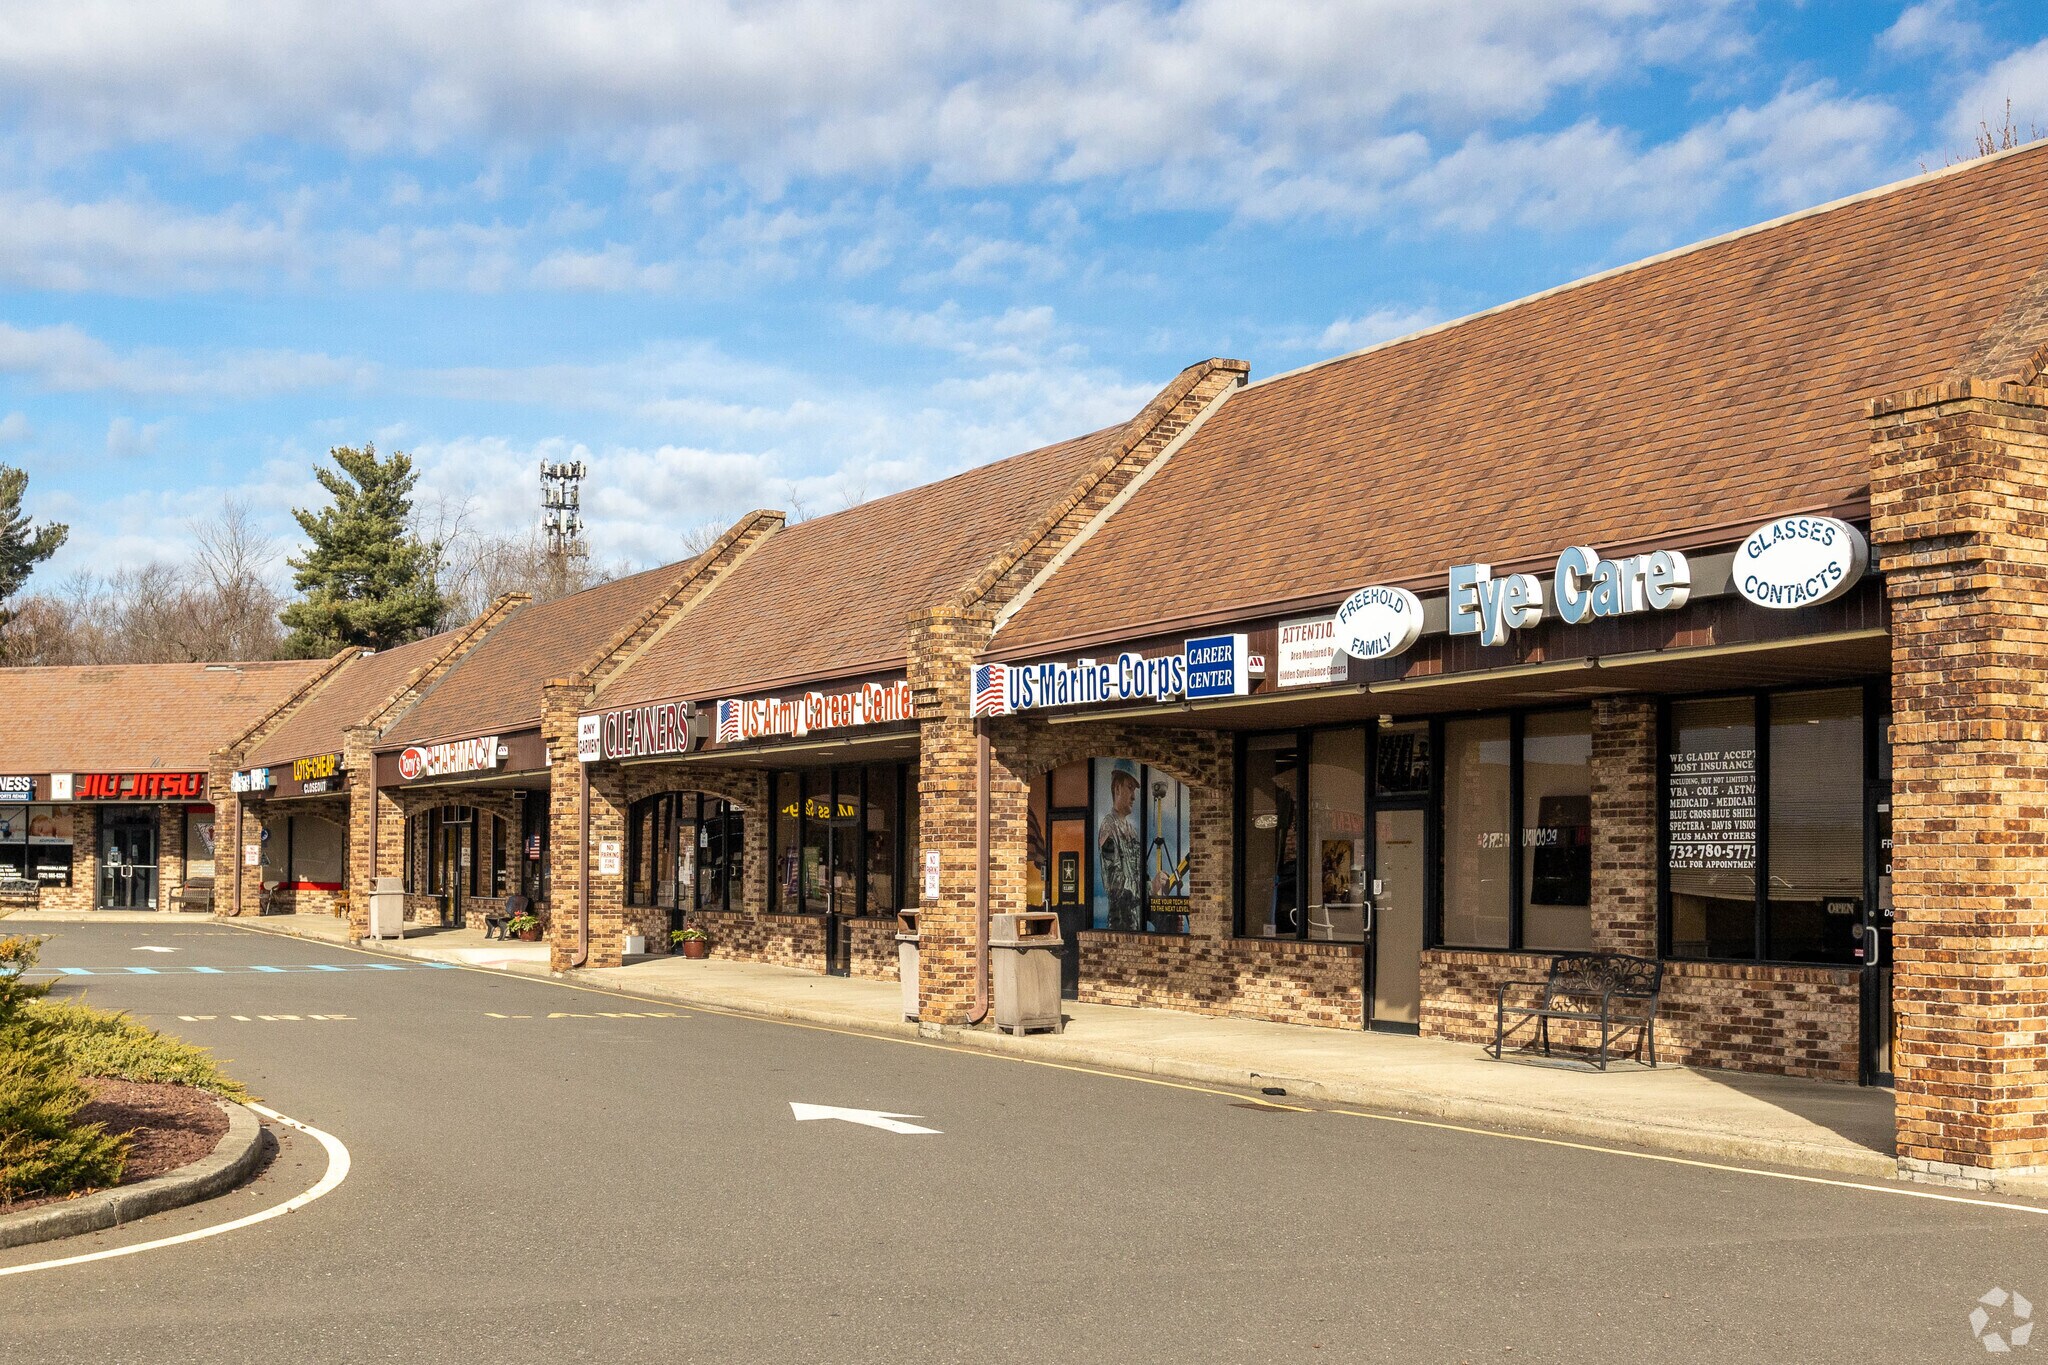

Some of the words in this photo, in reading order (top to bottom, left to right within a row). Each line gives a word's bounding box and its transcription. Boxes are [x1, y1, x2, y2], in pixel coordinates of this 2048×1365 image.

[1747, 520, 1836, 558] GLASSES
[1745, 561, 1842, 604] CONTACTS
[1449, 563, 1537, 647] Eye
[1555, 546, 1684, 625] Care
[1340, 588, 1404, 625] FREEHOLD
[1281, 621, 1336, 644] ATTENTIO
[1351, 632, 1391, 656] FAMILY
[1188, 645, 1232, 666] CAREER
[1290, 651, 1302, 661] Area
[1303, 648, 1327, 660] Monitored
[1328, 646, 1335, 658] By
[1009, 666, 1033, 709] US
[1039, 660, 1111, 708] Marine
[1118, 654, 1183, 701] Corps
[1188, 669, 1233, 690] CENTER
[1280, 670, 1296, 681] Hidden
[1327, 665, 1347, 676] Camera
[741, 700, 759, 738] US
[764, 698, 800, 738] Army
[804, 692, 857, 731] Career
[583, 723, 596, 735] ANY
[603, 700, 690, 760] CLEANERS
[578, 738, 600, 755] GARMENT
[401, 754, 421, 776] Tony's
[426, 736, 492, 777] PHARMACY
[1669, 754, 1684, 763] WE
[1686, 751, 1720, 762] GLADLY
[293, 754, 335, 781] LOTS-CHEAP
[1673, 762, 1698, 772] MOST
[1700, 760, 1754, 771] INSURANCE
[74, 774, 122, 797] JIU
[124, 774, 201, 797] JITSU
[303, 781, 327, 794] CLOSEOUT
[1701, 776, 1712, 785] BUT
[1713, 776, 1725, 784] NOT
[1725, 775, 1749, 784] LIMITED
[1670, 787, 1689, 797] VBA
[1696, 786, 1719, 796] COLE
[1669, 797, 1709, 808] MEDICAID
[1669, 810, 1687, 820] BLUE
[1689, 809, 1711, 819] CROSS
[1712, 808, 1731, 818] BLUE
[1669, 821, 1705, 831] SPECTERA
[1711, 820, 1732, 830] DAVIS
[1672, 832, 1692, 841] PLUS
[1694, 832, 1720, 841] MANY
[1722, 831, 1756, 840] OTHERS
[929, 855, 937, 865] NO
[1669, 860, 1687, 868] CALL
[1689, 860, 1704, 869] FOR
[1827, 902, 1854, 914] OPEN
